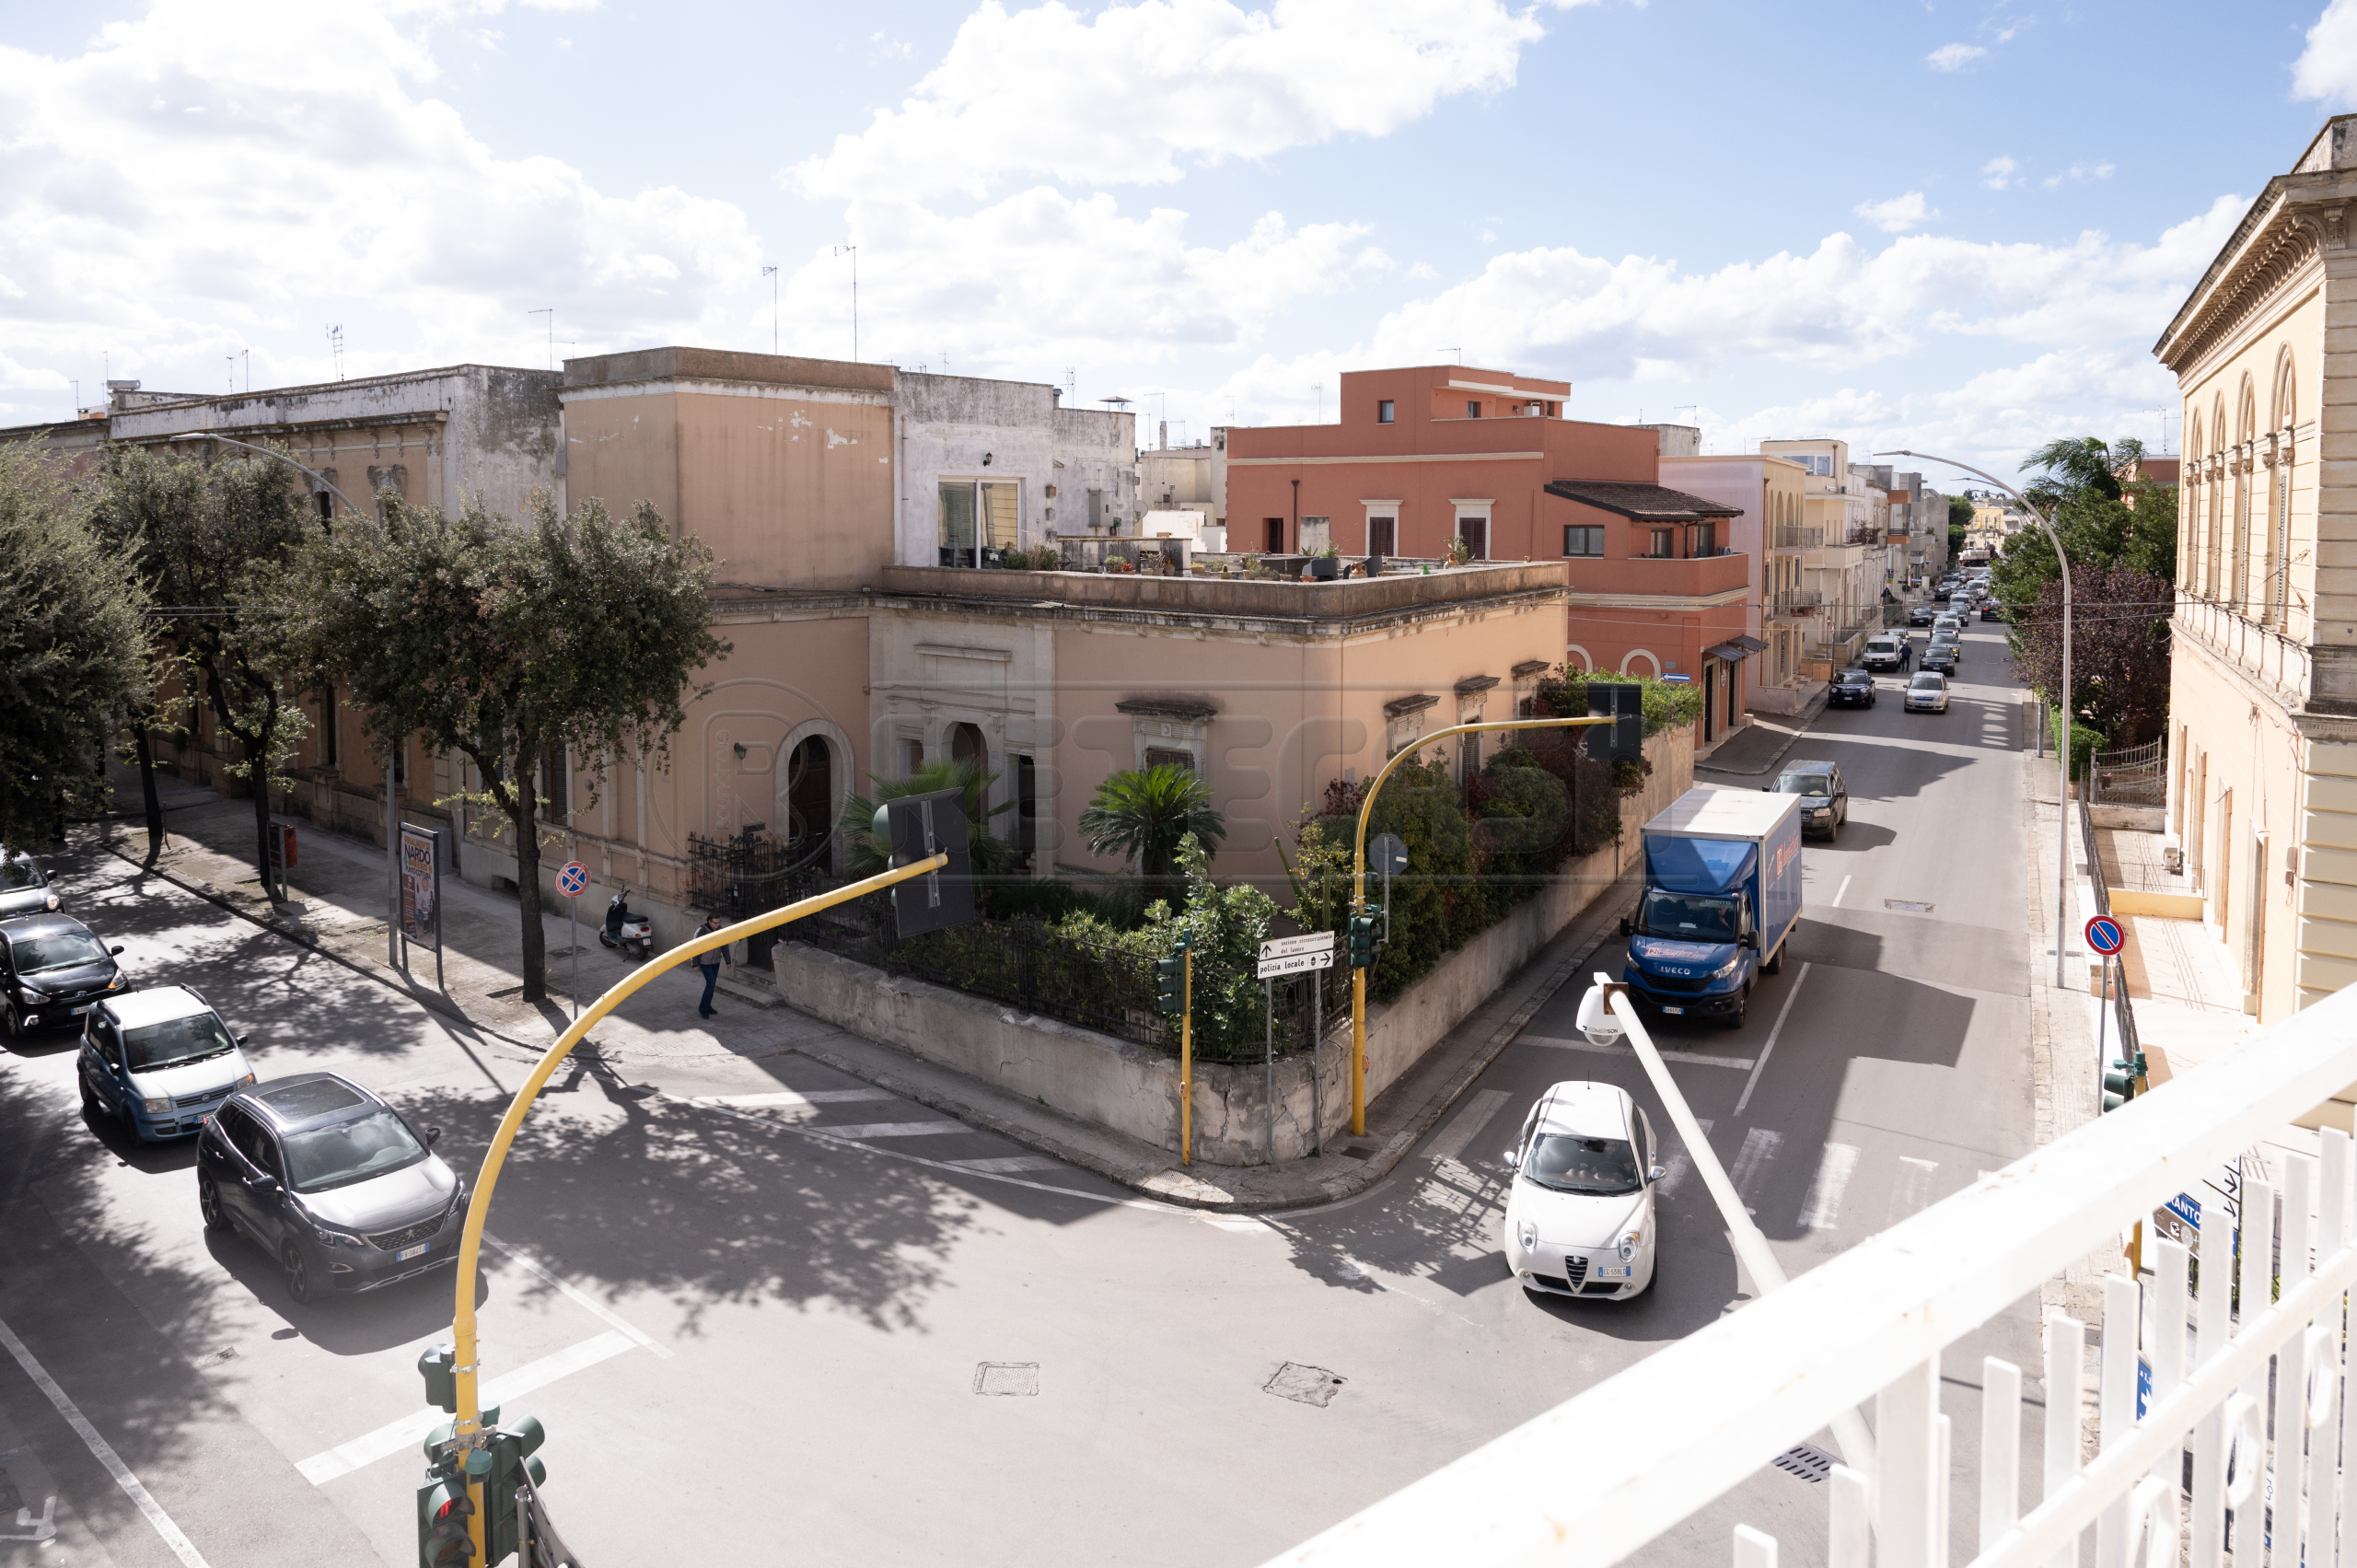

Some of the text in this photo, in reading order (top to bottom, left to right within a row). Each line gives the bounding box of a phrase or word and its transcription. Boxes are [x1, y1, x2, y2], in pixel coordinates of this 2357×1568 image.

[1299, 934, 1332, 944] circoscrizionale
[1260, 959, 1305, 974] polizia locale
[1661, 966, 1690, 975] IVECO
